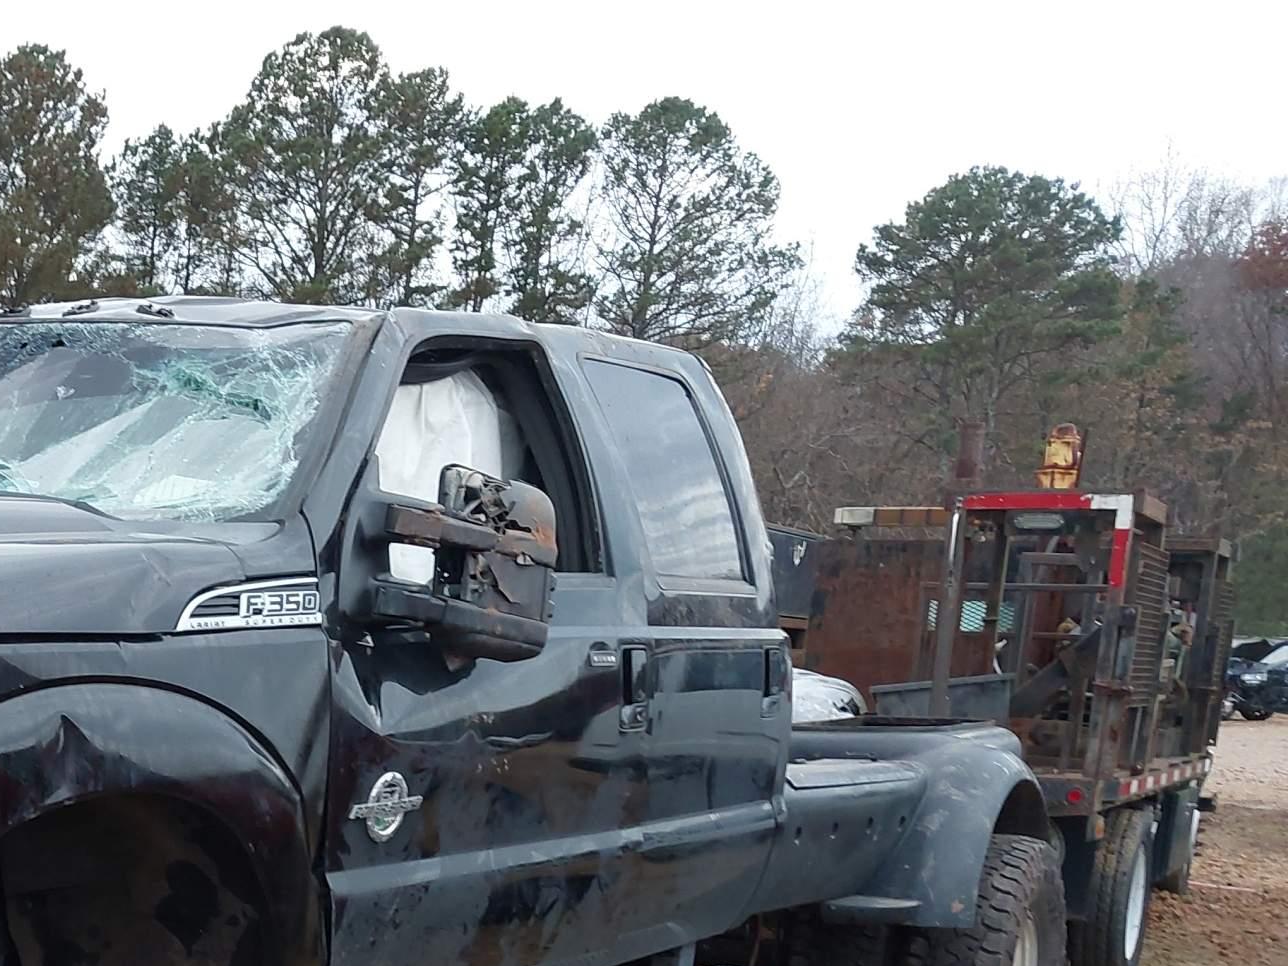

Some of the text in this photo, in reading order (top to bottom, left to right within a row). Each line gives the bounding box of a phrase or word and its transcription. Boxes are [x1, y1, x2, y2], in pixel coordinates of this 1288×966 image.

[240, 591, 320, 618] F-350
[245, 616, 318, 627] SUPER DUTY
